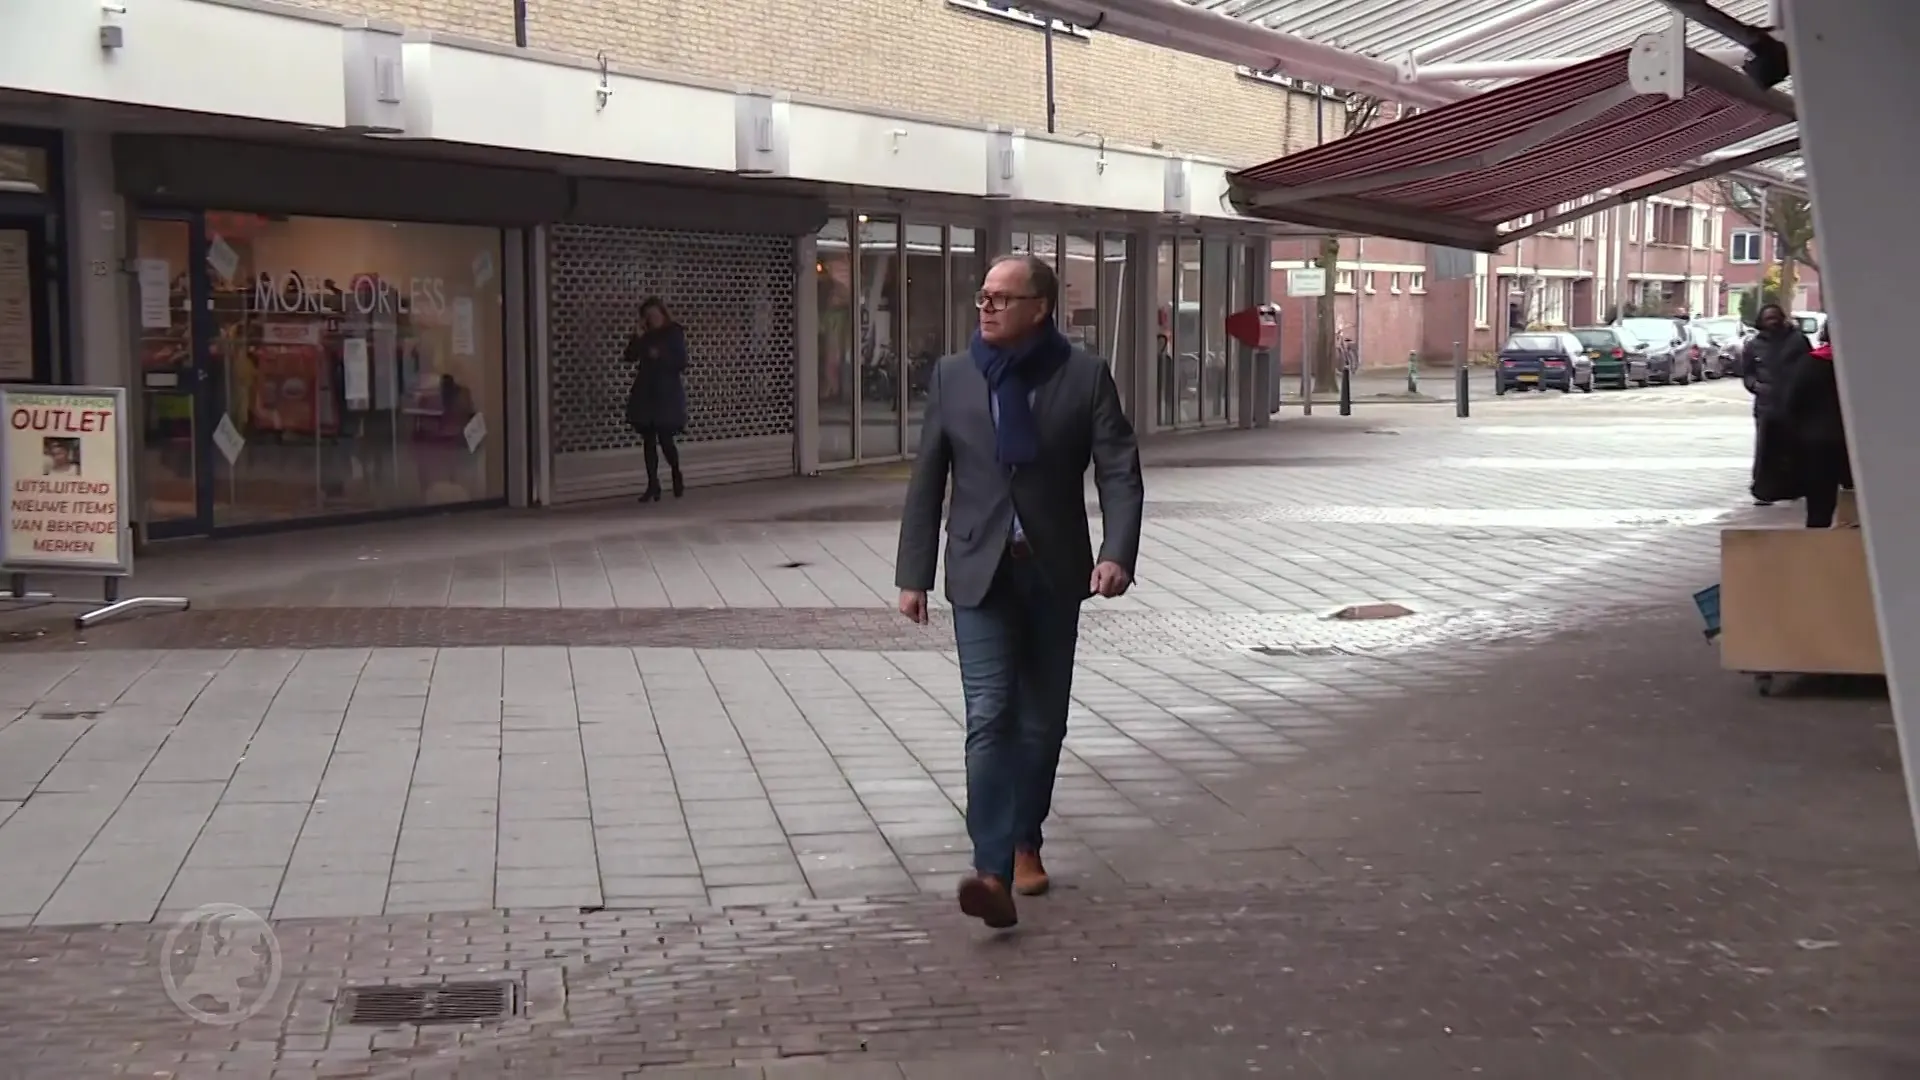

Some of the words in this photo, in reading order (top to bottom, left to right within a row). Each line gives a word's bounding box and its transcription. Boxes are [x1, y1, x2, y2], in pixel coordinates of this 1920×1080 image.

[254, 271, 335, 312] MORE
[397, 276, 447, 317] LESS
[11, 409, 112, 431] OUTLET
[15, 481, 110, 495] UITSLUITEND
[11, 500, 69, 513] NIEUWE
[72, 501, 116, 514] ITEMS
[12, 520, 42, 531] VAN
[46, 520, 117, 534] BEKENDE
[33, 539, 95, 553] MERKEN
